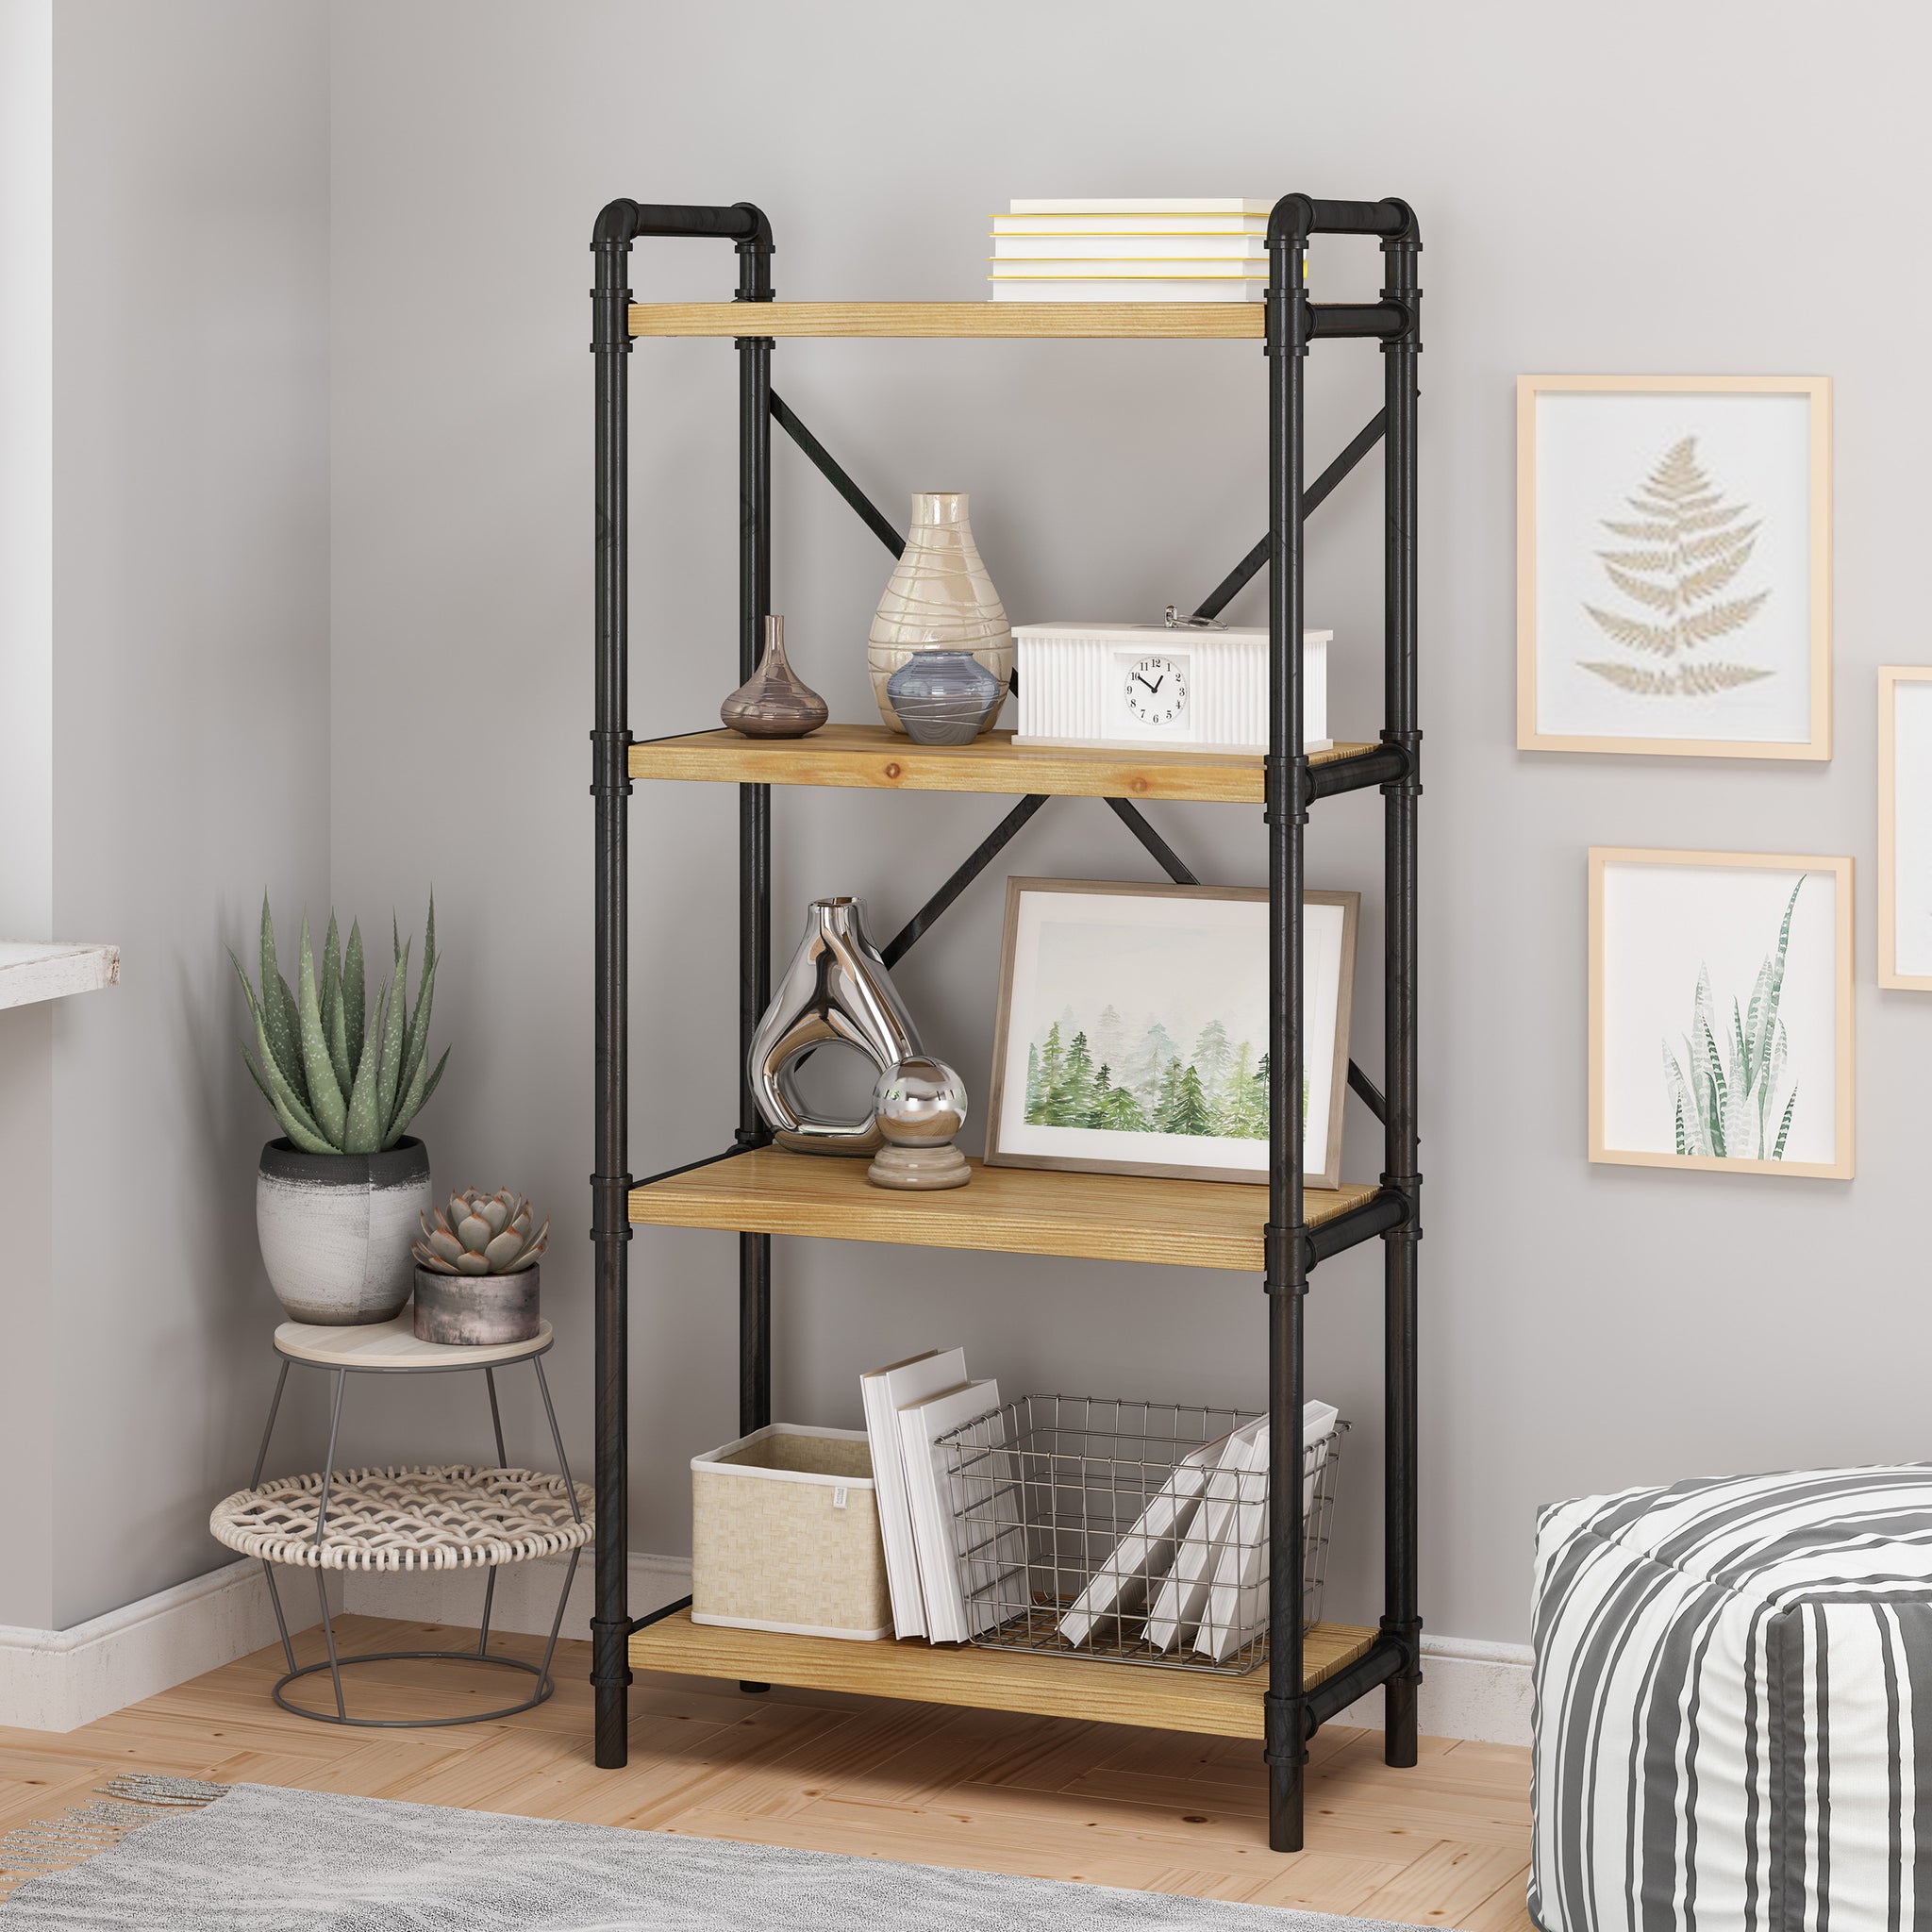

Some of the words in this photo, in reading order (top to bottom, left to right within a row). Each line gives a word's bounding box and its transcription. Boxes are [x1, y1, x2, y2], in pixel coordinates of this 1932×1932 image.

[1141, 662, 1148, 671] 11
[1152, 658, 1160, 668] 12
[1167, 663, 1171, 672] 1
[1175, 674, 1181, 682] 2
[1126, 686, 1132, 694] 9
[1179, 687, 1185, 696] 3
[1130, 699, 1137, 708] 8
[1175, 699, 1181, 709] 4
[1141, 709, 1145, 718] 7
[1166, 710, 1172, 719] 5
[1153, 714, 1158, 724] 6
